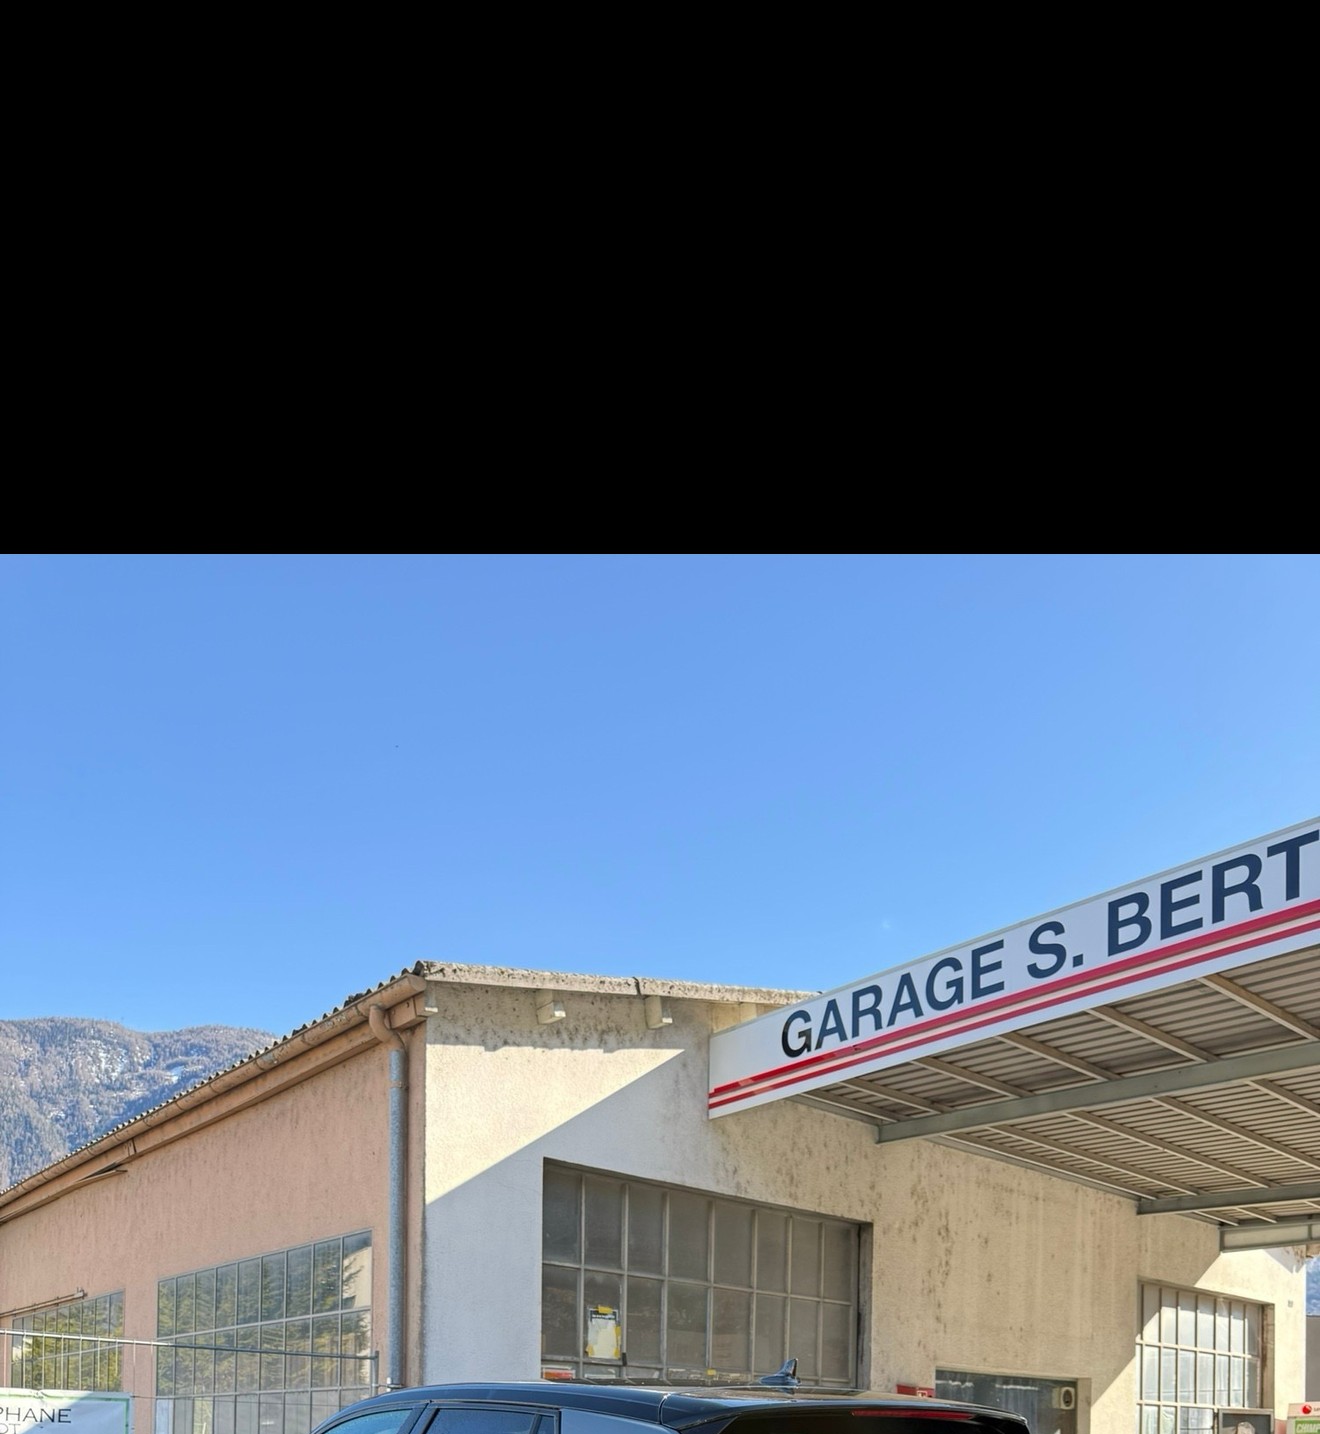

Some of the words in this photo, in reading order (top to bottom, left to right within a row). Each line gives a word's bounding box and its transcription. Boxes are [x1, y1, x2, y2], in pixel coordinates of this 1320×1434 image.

[781, 939, 1005, 1058] GARAGE
[1027, 921, 1084, 980] S.
[1107, 829, 1320, 957] BERT
[0, 1407, 72, 1424] HANE
